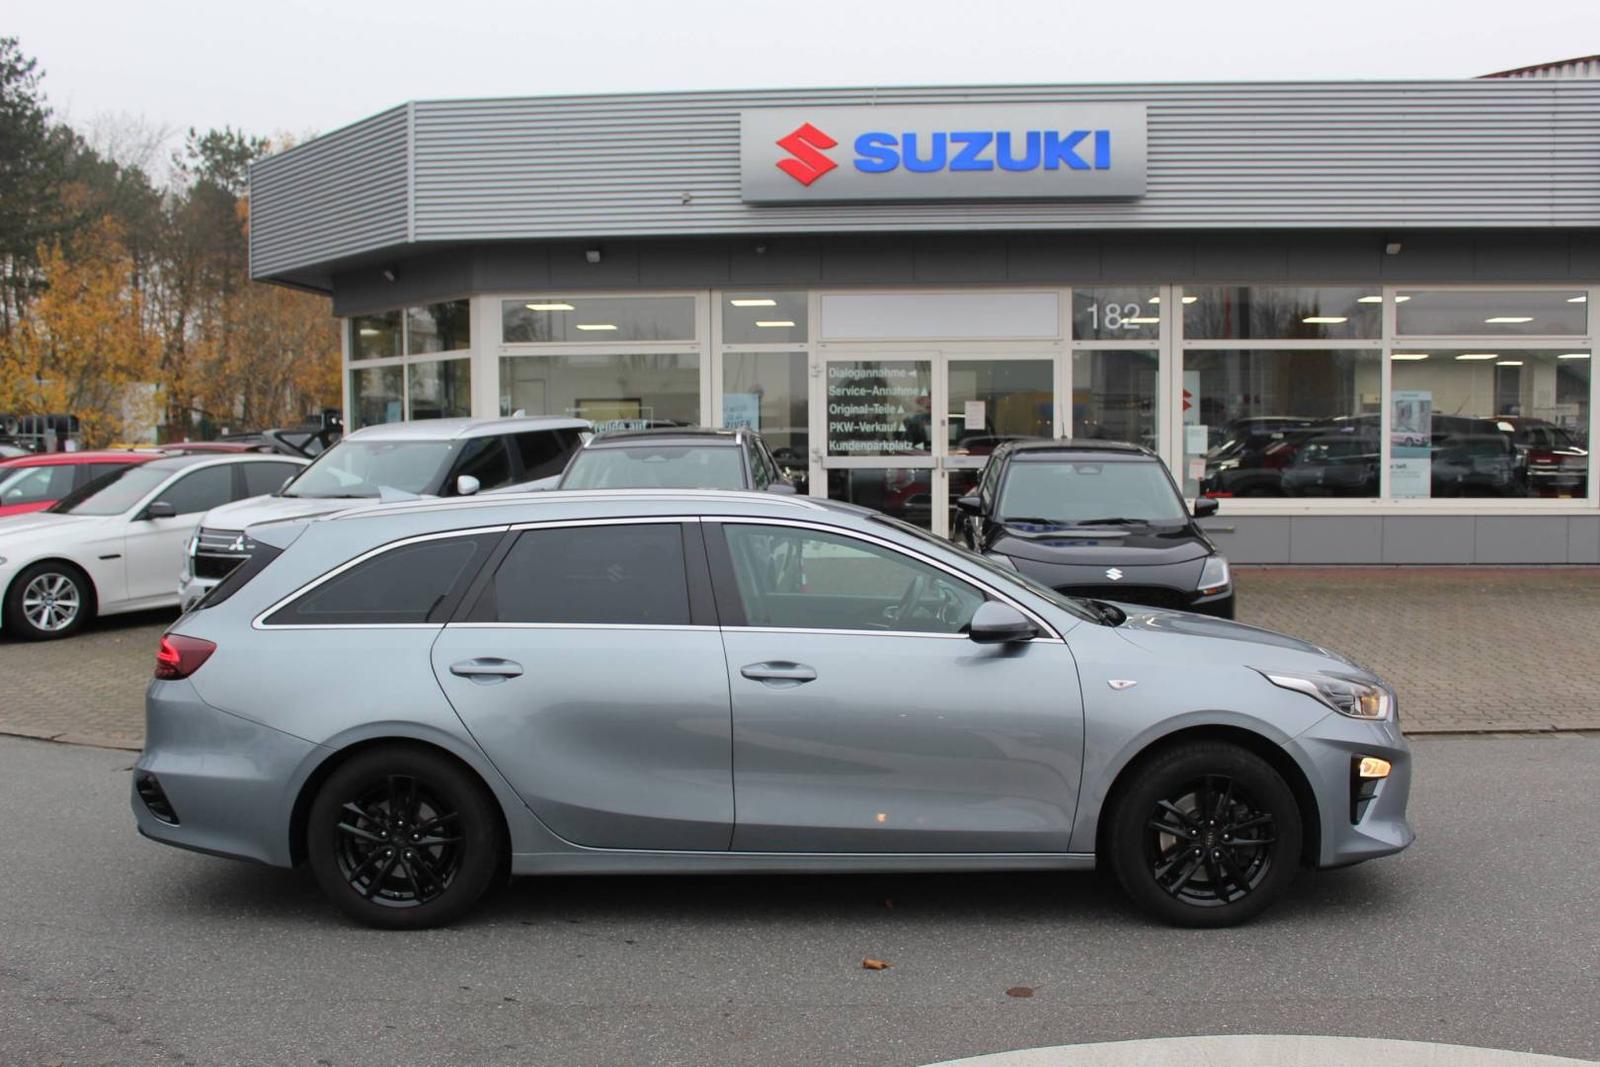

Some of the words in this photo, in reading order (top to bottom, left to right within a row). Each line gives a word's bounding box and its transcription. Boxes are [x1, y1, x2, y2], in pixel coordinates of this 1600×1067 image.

[854, 130, 1111, 174] SUZUKI
[1087, 303, 1140, 329] 182
[829, 367, 906, 379] Dialogannahme
[829, 385, 919, 396] Service-Annahme
[829, 404, 896, 417] Original-Teile
[829, 421, 897, 433] PKW-Verkauf
[829, 440, 914, 453] Kundenparkplatz
